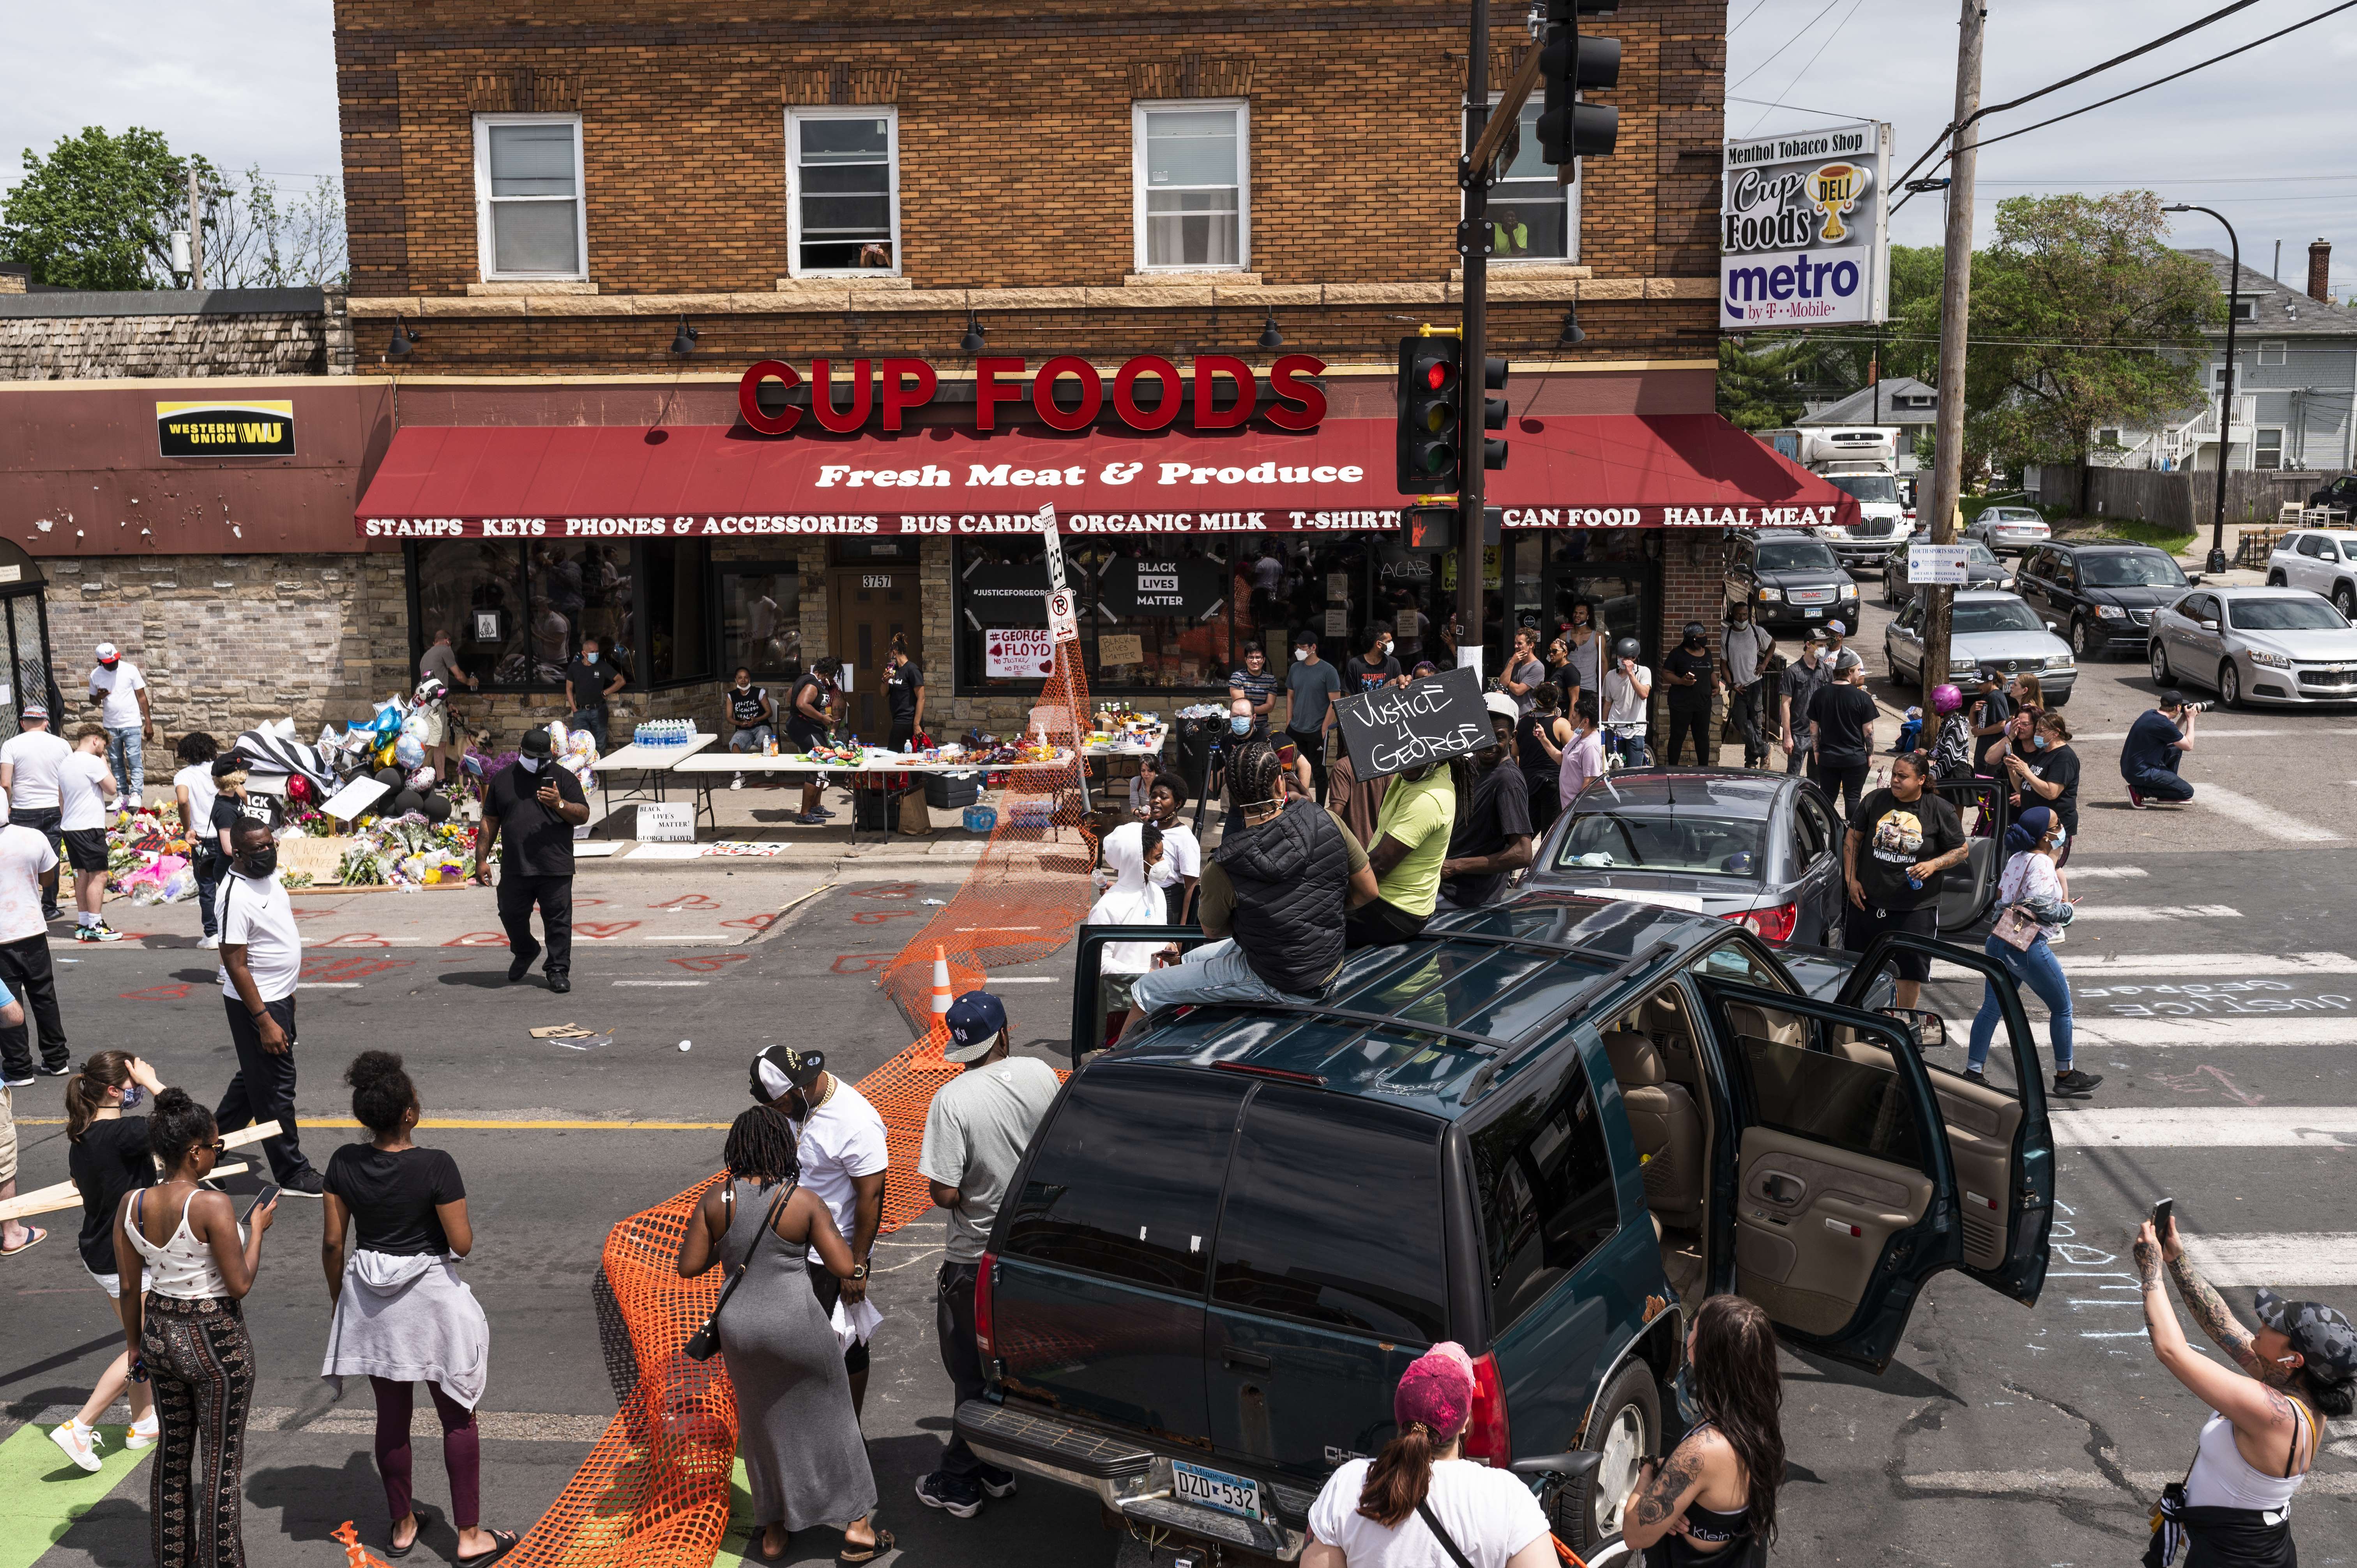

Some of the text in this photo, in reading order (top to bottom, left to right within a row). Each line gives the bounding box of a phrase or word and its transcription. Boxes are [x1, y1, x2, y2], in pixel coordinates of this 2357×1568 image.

[1728, 133, 1862, 165] Menthol Tobacco Shop
[1733, 171, 1805, 216] Cup
[1819, 178, 1850, 202] DELI
[1725, 208, 1809, 249] Foods
[1729, 254, 1859, 301] metro
[1749, 305, 1762, 323] by
[739, 354, 1329, 434] CUP FOODS
[169, 423, 235, 434] WESTERN
[242, 423, 282, 443] WU
[191, 433, 236, 443] UNION
[815, 461, 1364, 488] Fresh Meat & Produce
[366, 518, 463, 537] STAMPS
[482, 518, 546, 536] KEYS
[565, 517, 666, 535] PHONES
[673, 517, 694, 533] &
[701, 516, 878, 534] ACCESSORIES
[900, 516, 952, 533] BUS
[958, 515, 1044, 533] CARDS
[1069, 514, 1191, 532] ORGANIC
[1199, 512, 1267, 530] MILK
[1567, 508, 1641, 526] FOOD
[1663, 507, 1753, 526] HALAL
[1759, 506, 1836, 526] MEAT
[1043, 514, 1055, 530] SPEED
[1047, 531, 1057, 547] LIMIT
[1050, 547, 1063, 582] 25
[1138, 563, 1176, 572] BLACK
[1381, 560, 1434, 580] ACAB
[864, 576, 890, 587] 3757
[1143, 579, 1174, 588] LIVES
[1137, 596, 1183, 605] MATTER
[1062, 618, 1072, 626] STOP
[1005, 643, 1051, 656] FLOYD
[1101, 637, 1131, 648] BLACK
[1105, 652, 1136, 660] MATTER
[1396, 720, 1417, 740] 4
[1372, 724, 1486, 772] GEORGE
[286, 840, 336, 856] SO WHEN
[1873, 849, 1917, 863] MANDALORIAN
[290, 855, 304, 867] YOU
[2078, 979, 2293, 998] GEORGE
[2108, 994, 2352, 1017] JUSTICE
[1178, 1471, 1254, 1511] DZD 532
[1180, 1492, 1189, 1500] AUG
[1202, 1499, 1234, 1511] 10,000 lakes
[1693, 1526, 1730, 1541] Klein
